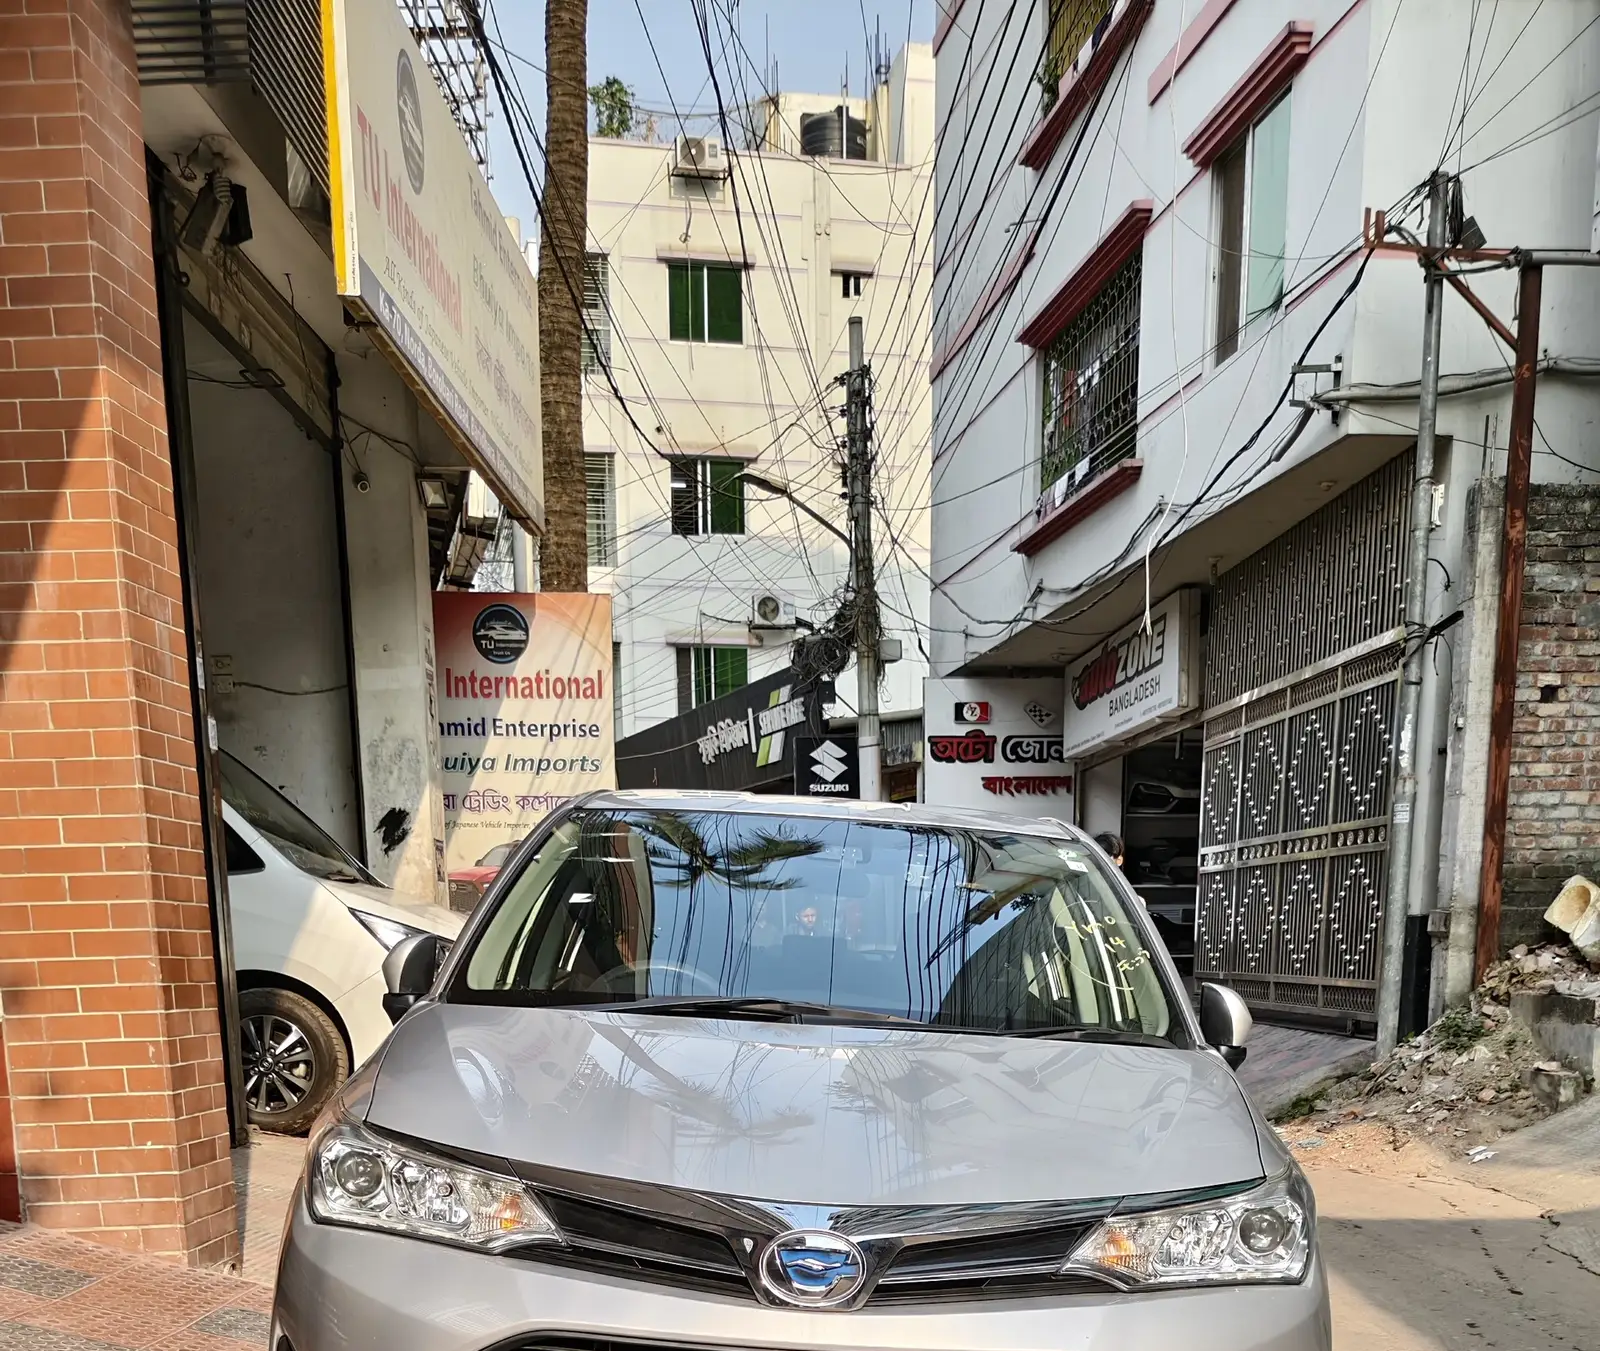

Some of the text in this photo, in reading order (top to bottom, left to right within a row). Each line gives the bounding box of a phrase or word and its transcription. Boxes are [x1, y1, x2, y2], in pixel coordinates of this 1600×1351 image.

[356, 102, 463, 339] TU International
[467, 171, 498, 253] Tahmid
[383, 255, 397, 287] All
[378, 286, 404, 344] Ka-70,
[480, 640, 495, 649] TU
[445, 667, 603, 700] International
[1109, 675, 1161, 717] BANGLADESH
[493, 718, 600, 742] Enterprise
[929, 730, 996, 762] অটো
[504, 754, 601, 776] Imports
[462, 788, 512, 813] ট্রেডিং
[809, 783, 849, 792] SUZUKI
